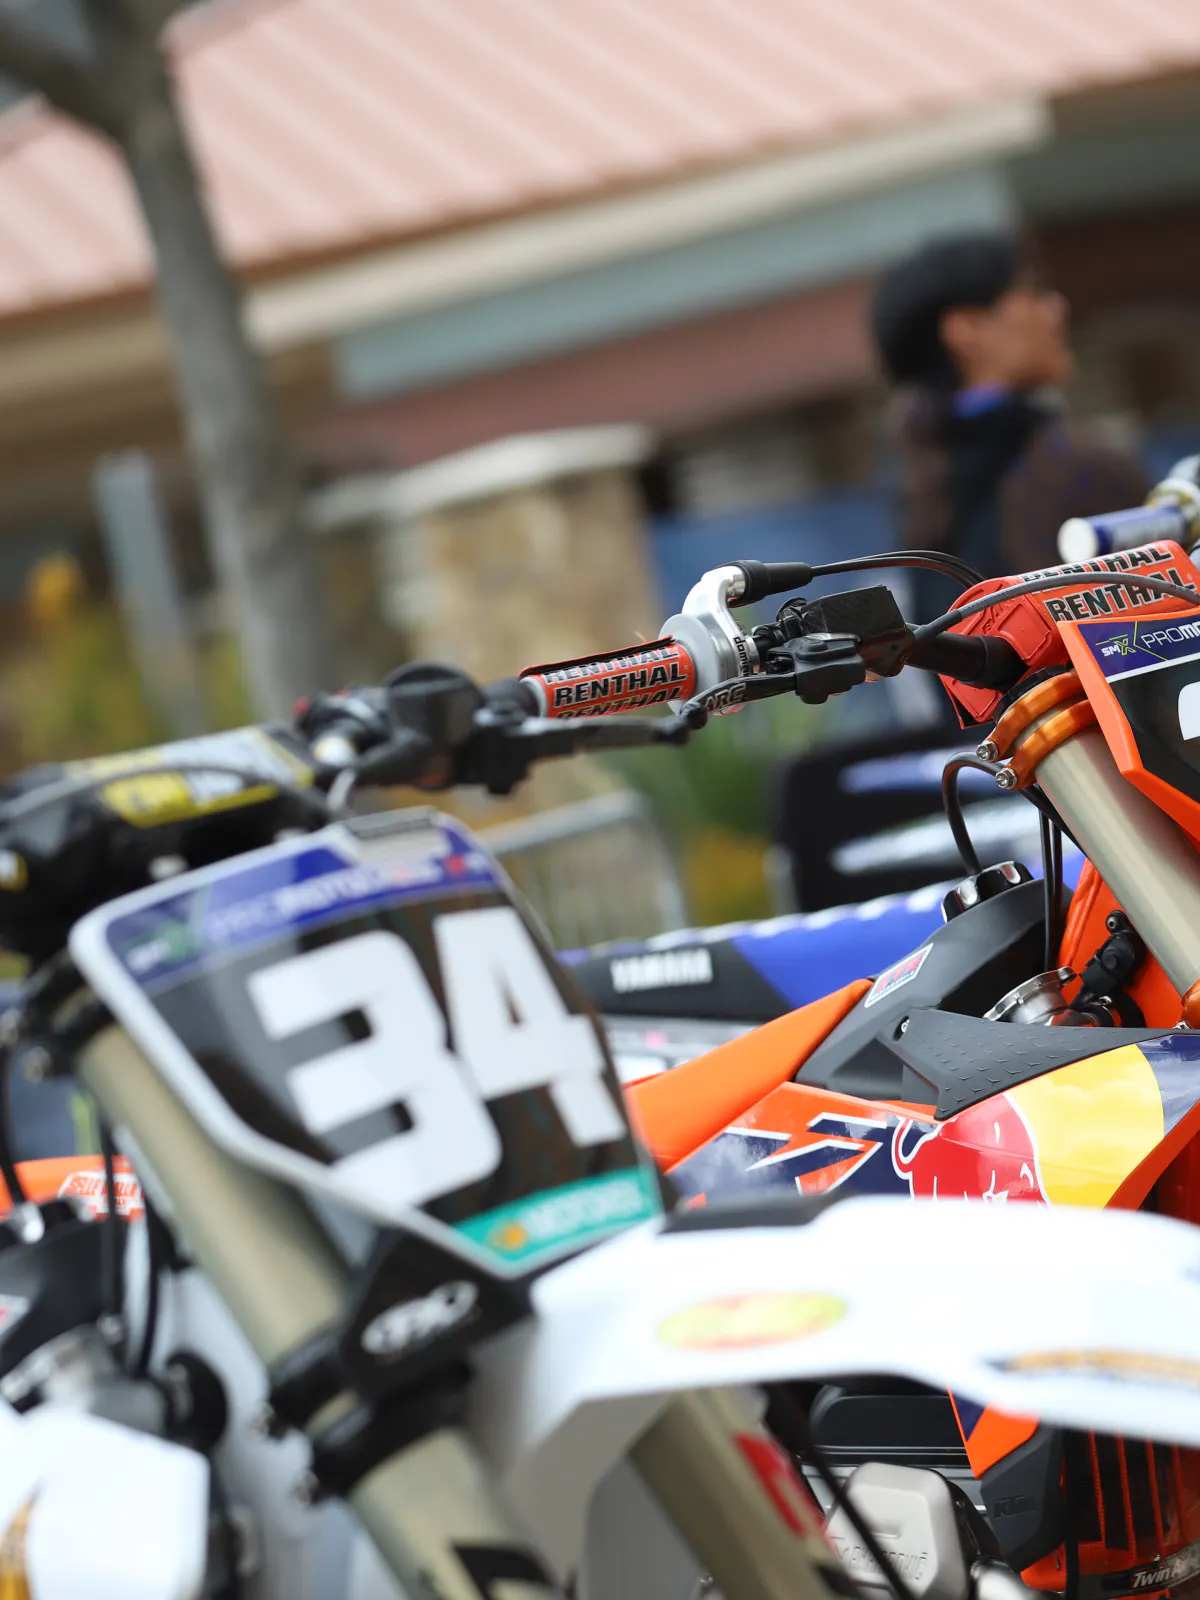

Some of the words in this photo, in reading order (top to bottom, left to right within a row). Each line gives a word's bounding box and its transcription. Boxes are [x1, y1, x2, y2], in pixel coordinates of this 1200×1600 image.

[1044, 568, 1197, 622] RENTHAL
[1101, 637, 1138, 657] SMX
[553, 663, 687, 708] RENTHAL
[248, 906, 628, 1210] 34
